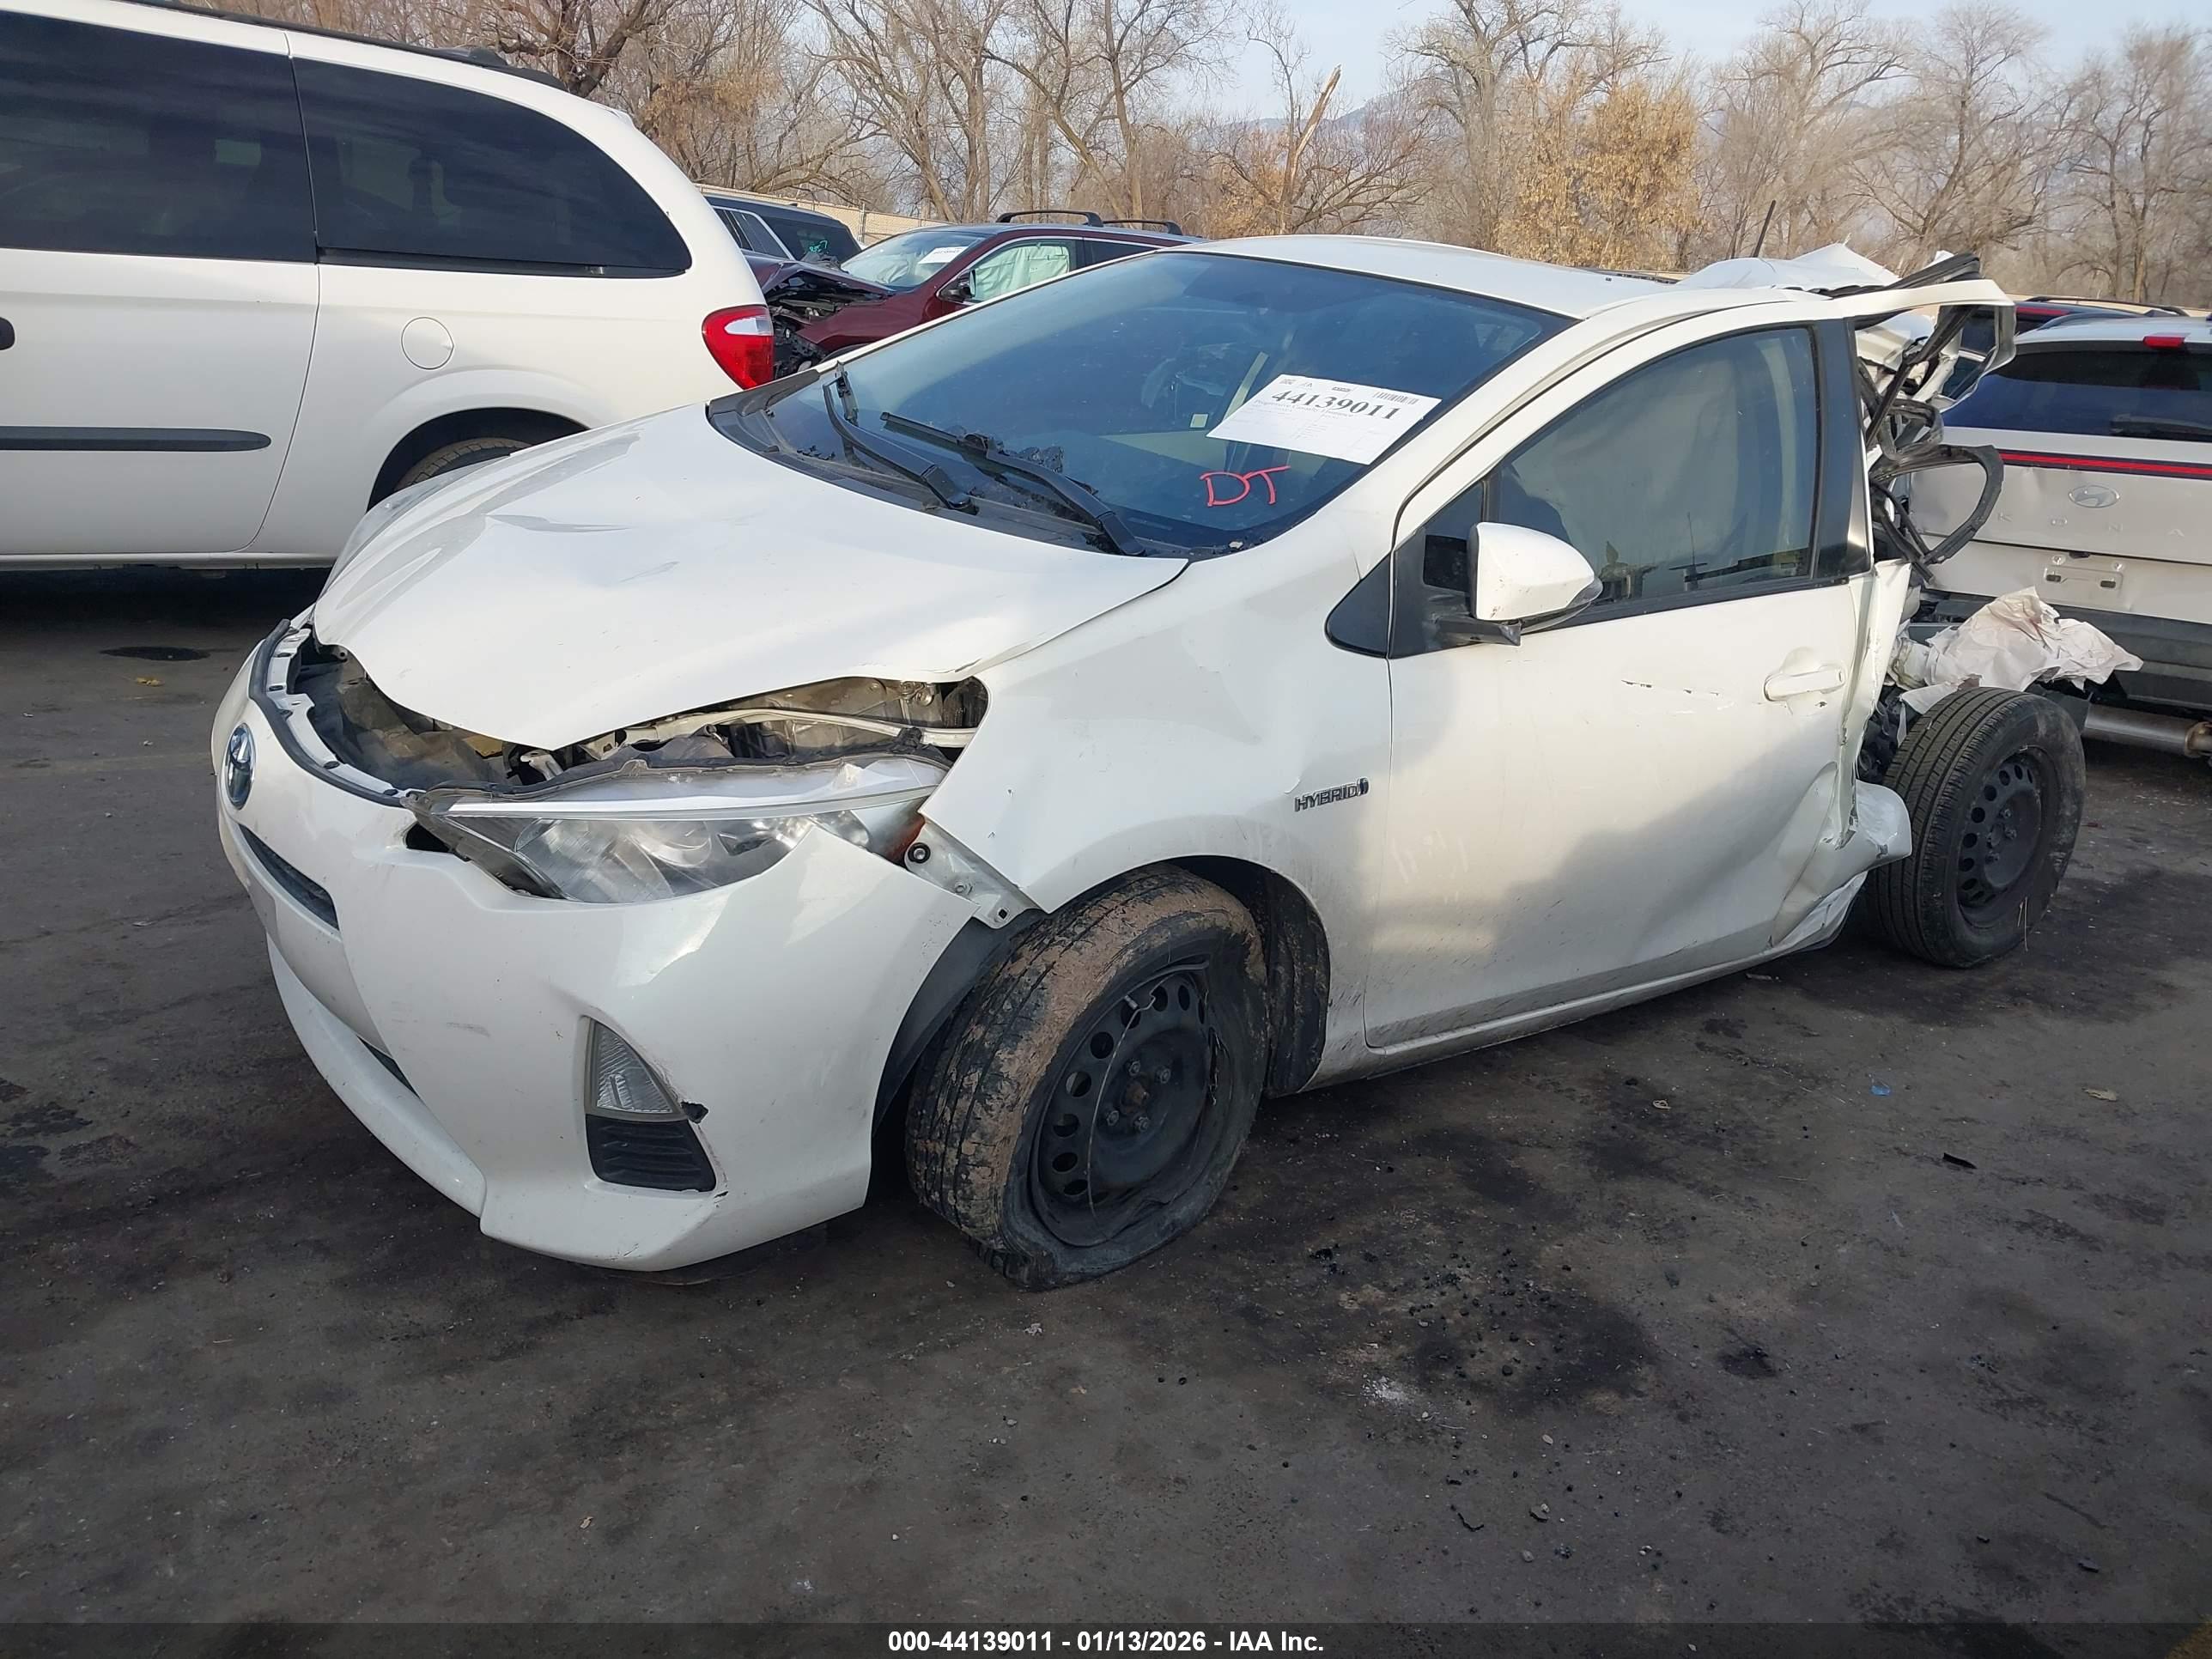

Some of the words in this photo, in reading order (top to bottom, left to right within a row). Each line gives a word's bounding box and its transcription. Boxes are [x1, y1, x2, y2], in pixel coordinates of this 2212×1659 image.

[1272, 391, 1402, 419] 44139011
[1200, 466, 1291, 506] DT
[1998, 512, 2185, 537] KONA
[1295, 783, 1358, 811] HYBRID
